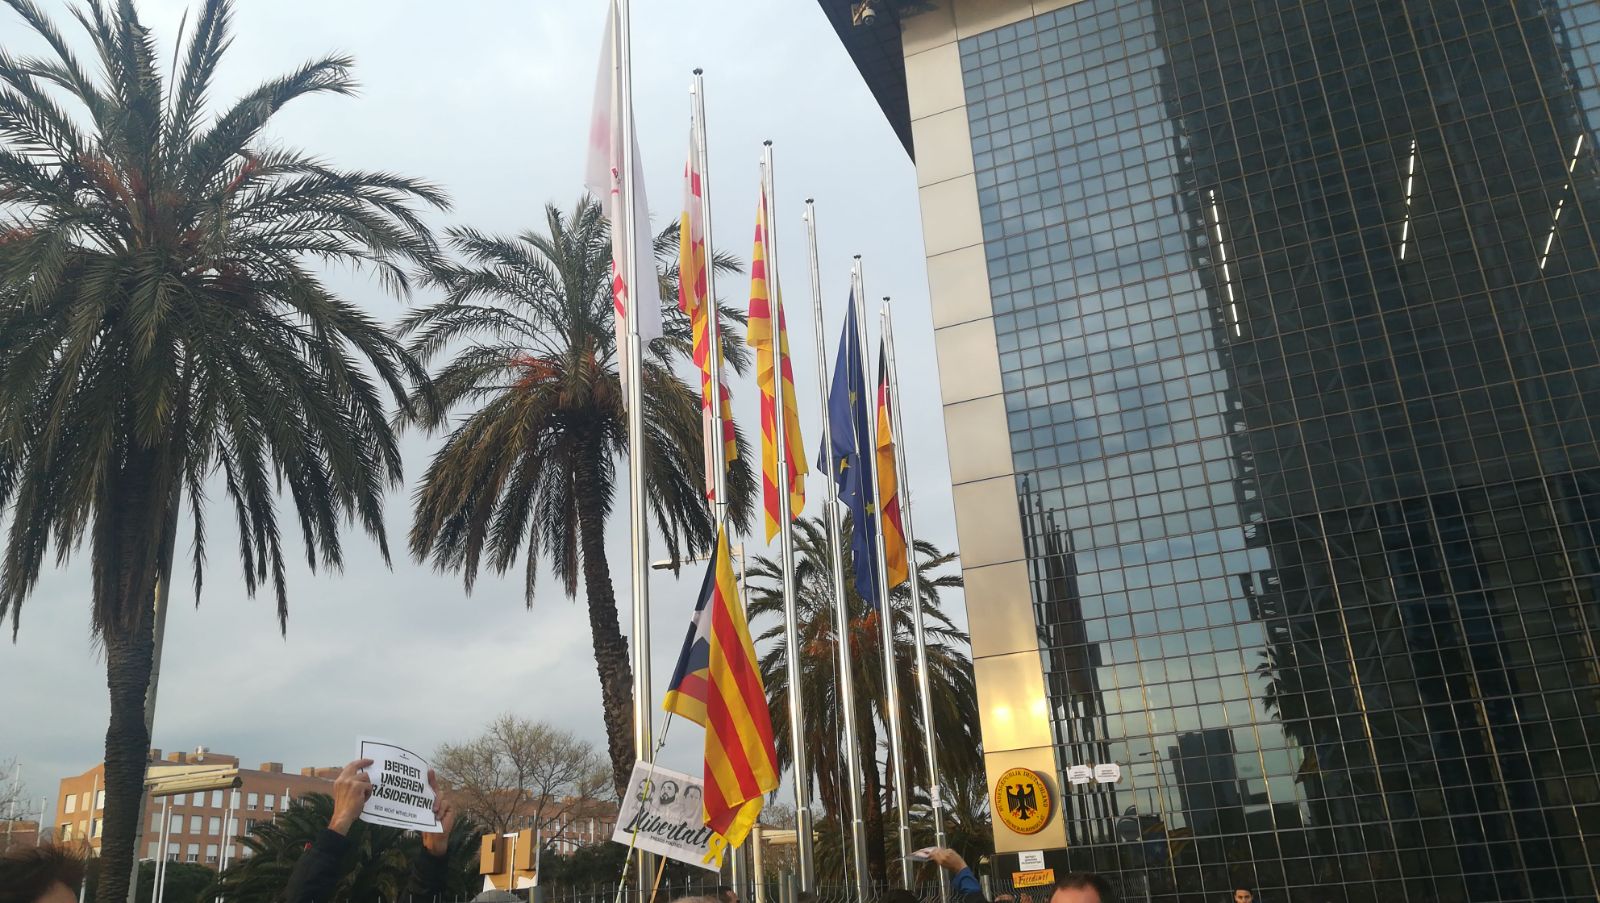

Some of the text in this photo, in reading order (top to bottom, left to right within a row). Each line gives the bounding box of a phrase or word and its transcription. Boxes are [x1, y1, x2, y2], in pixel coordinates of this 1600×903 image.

[384, 760, 421, 779] BEFREIT
[381, 773, 424, 793] UNSEREN
[371, 784, 433, 810] RÄSIDENTEN!
